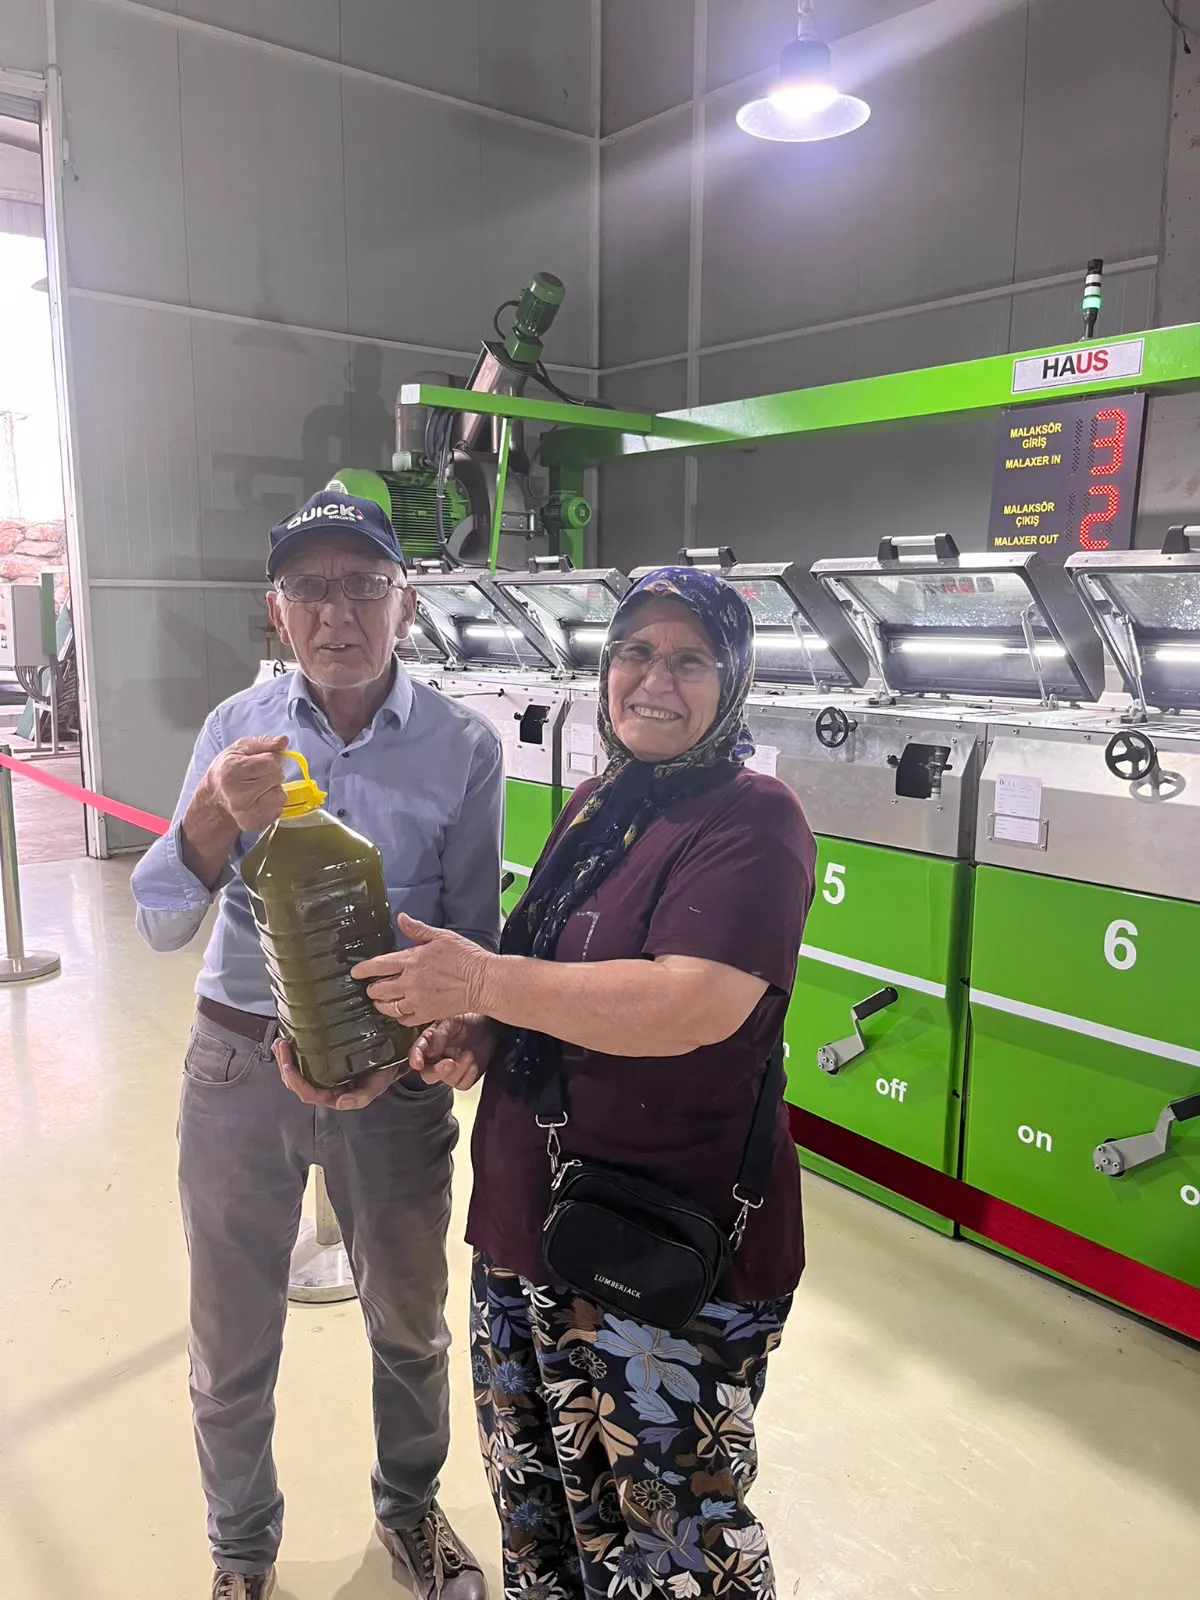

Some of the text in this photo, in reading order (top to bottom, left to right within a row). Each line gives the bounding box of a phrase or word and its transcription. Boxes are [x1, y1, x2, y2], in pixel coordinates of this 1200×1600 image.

[1042, 349, 1109, 379] HAUS
[1010, 421, 1062, 438] MALAKSÖR
[1022, 436, 1047, 449] GİRİŞ
[1090, 408, 1126, 476] 3
[1005, 454, 1061, 469] MALAXER IN
[287, 503, 356, 530] QUICK
[1003, 501, 1055, 515] MALAKSÖR
[1079, 485, 1118, 549] 2
[1015, 515, 1040, 528] ÇIKIŞ
[994, 534, 1059, 546] MALAXER OUT
[822, 861, 846, 905] 5
[1104, 918, 1138, 970] 6
[875, 1078, 908, 1103] off
[1017, 1124, 1052, 1153] on
[594, 1273, 641, 1299] LUMBERJACK
